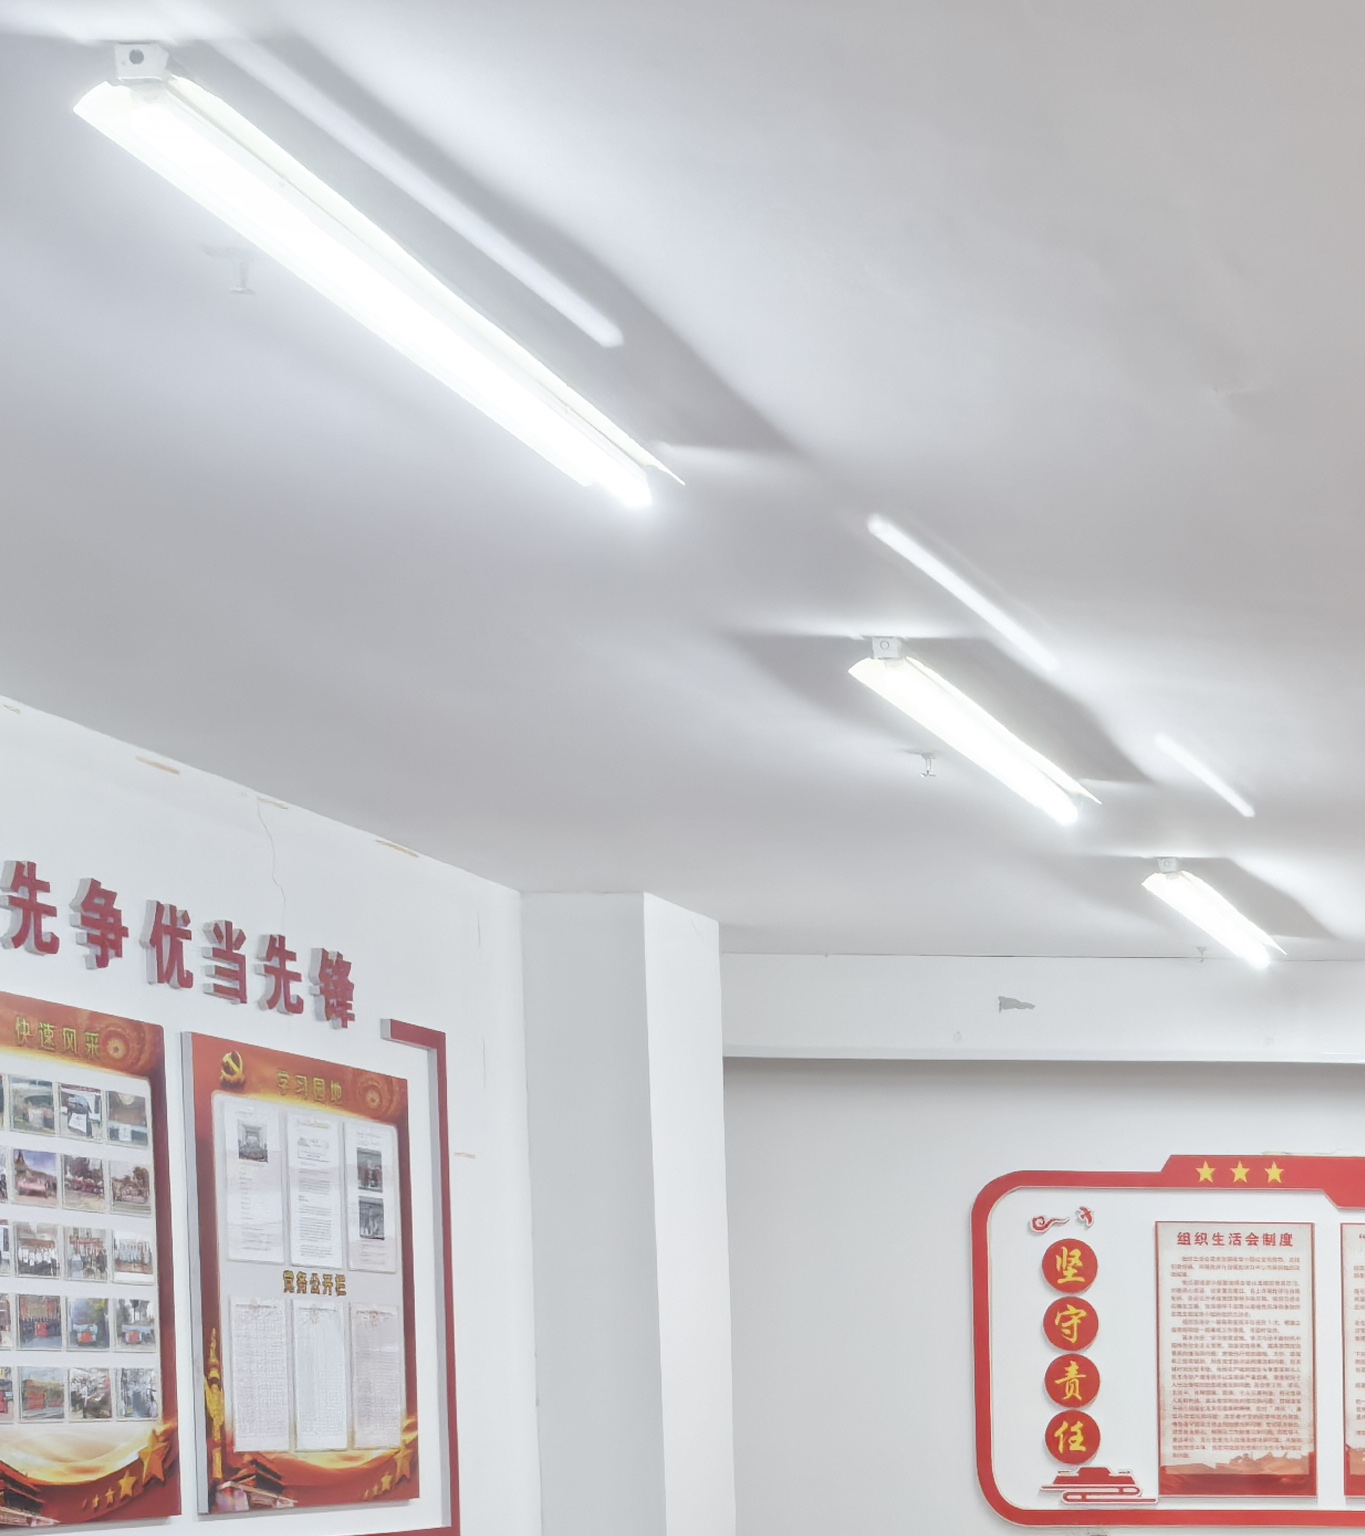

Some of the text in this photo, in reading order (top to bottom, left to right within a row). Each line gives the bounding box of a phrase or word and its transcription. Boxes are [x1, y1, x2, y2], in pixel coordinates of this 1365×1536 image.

[4, 860, 355, 1029] 先争优当先锋
[15, 1016, 101, 1057] 快速风采
[1176, 1231, 1293, 1248] 组织生活会制度
[1054, 1246, 1087, 1454] 坚守责任
